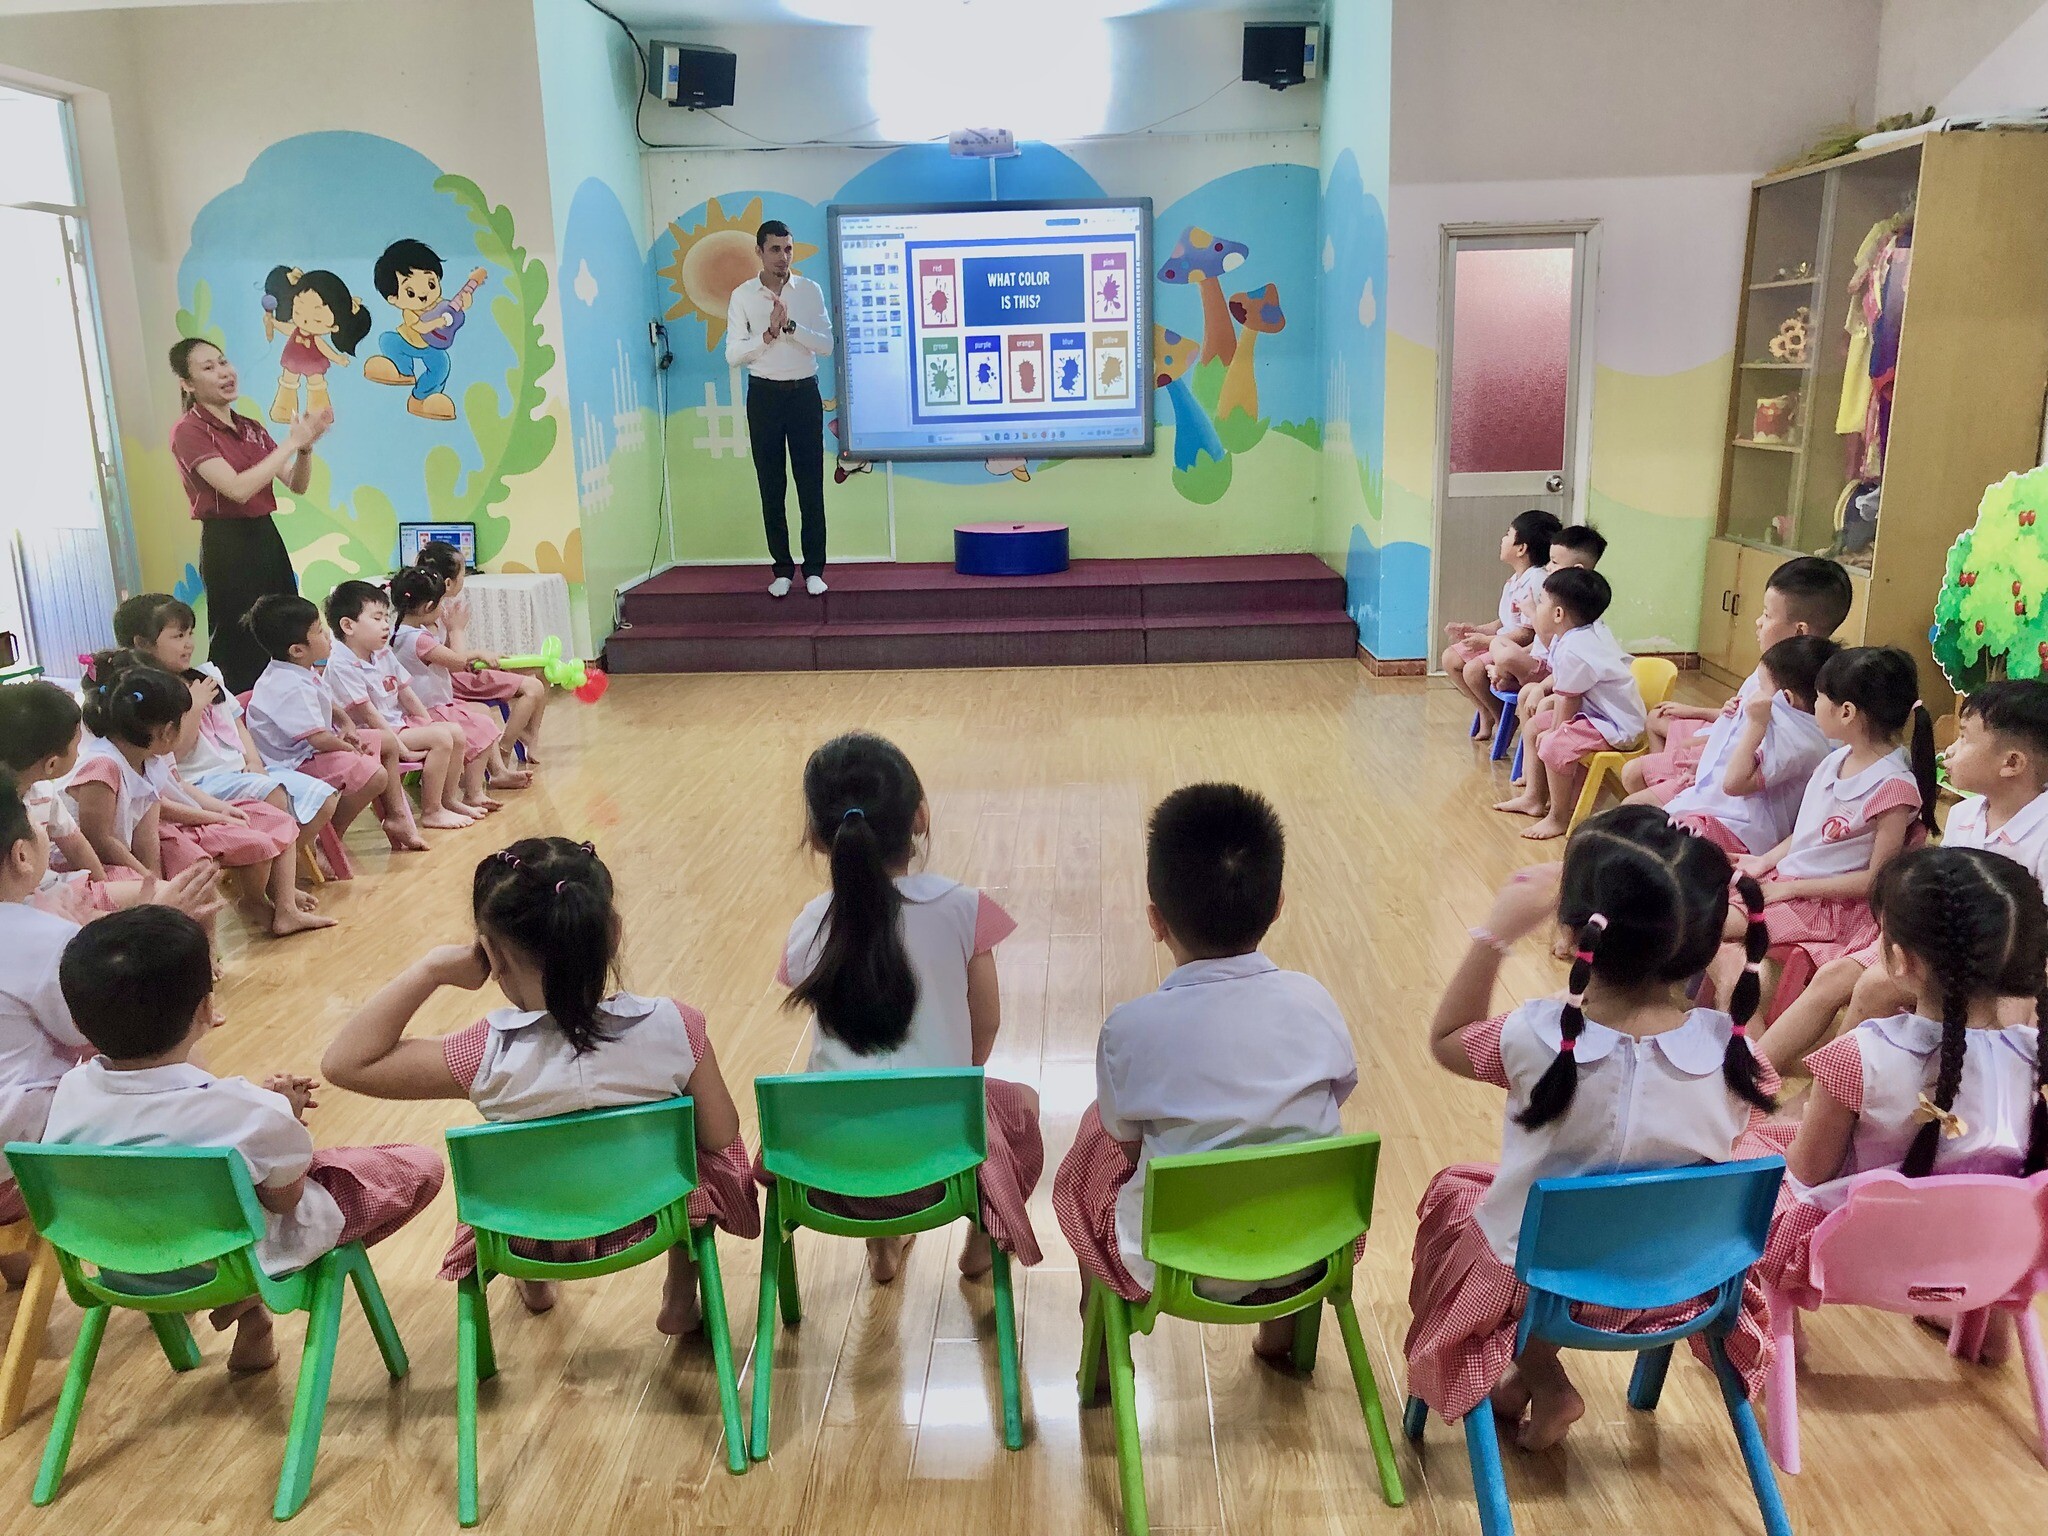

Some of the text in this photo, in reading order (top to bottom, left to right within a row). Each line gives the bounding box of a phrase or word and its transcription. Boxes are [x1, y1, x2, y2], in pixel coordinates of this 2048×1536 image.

[987, 271, 1050, 287] WHAT COLOR
[1001, 294, 1041, 310] IS THIS?
[974, 341, 992, 350] purple
